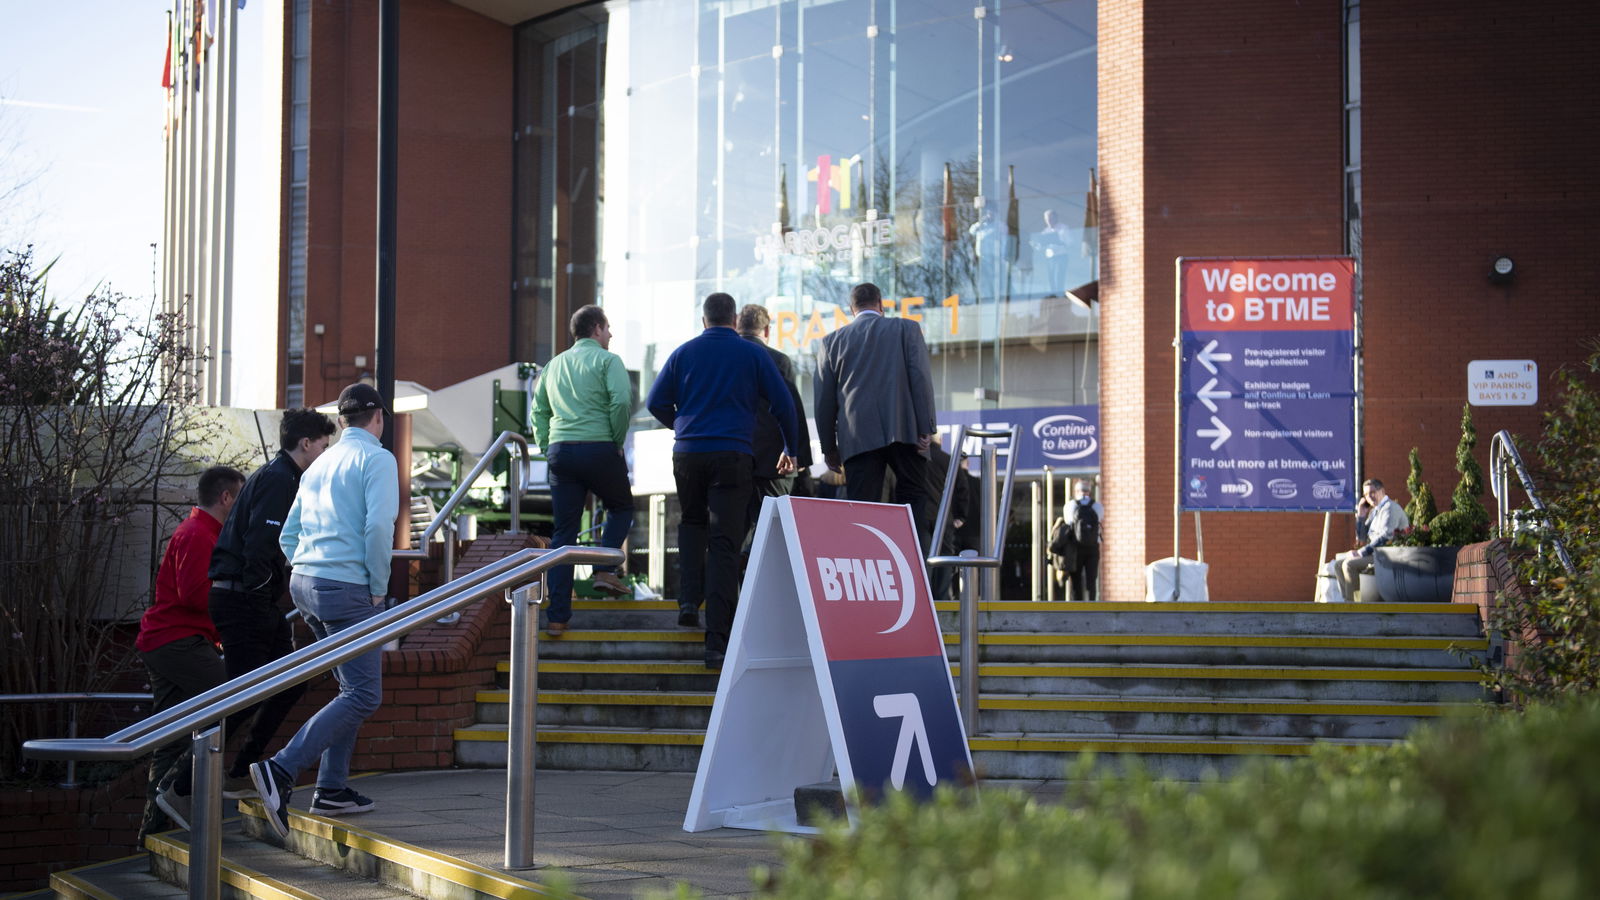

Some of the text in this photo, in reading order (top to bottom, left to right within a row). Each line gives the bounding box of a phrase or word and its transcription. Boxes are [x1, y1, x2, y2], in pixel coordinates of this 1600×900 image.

[1201, 268, 1336, 292] Welcome
[943, 294, 959, 335] 1
[1205, 297, 1330, 322] to BTME
[1244, 348, 1326, 357] Pre-registered visitor
[1244, 358, 1308, 368] badge collection
[1244, 381, 1310, 390] Exhibitor badges
[1244, 391, 1331, 399] and Continue to Learn
[1480, 392, 1501, 400] BAYS
[1521, 392, 1527, 400] 2
[1244, 401, 1281, 409] fast-track
[1042, 424, 1096, 437] Continue
[1244, 430, 1302, 438] Non-registered
[937, 422, 1010, 456] TME
[1042, 436, 1088, 450] to learn
[1191, 458, 1345, 471] Find out more at btme.org.uk
[816, 557, 900, 601] BTME
